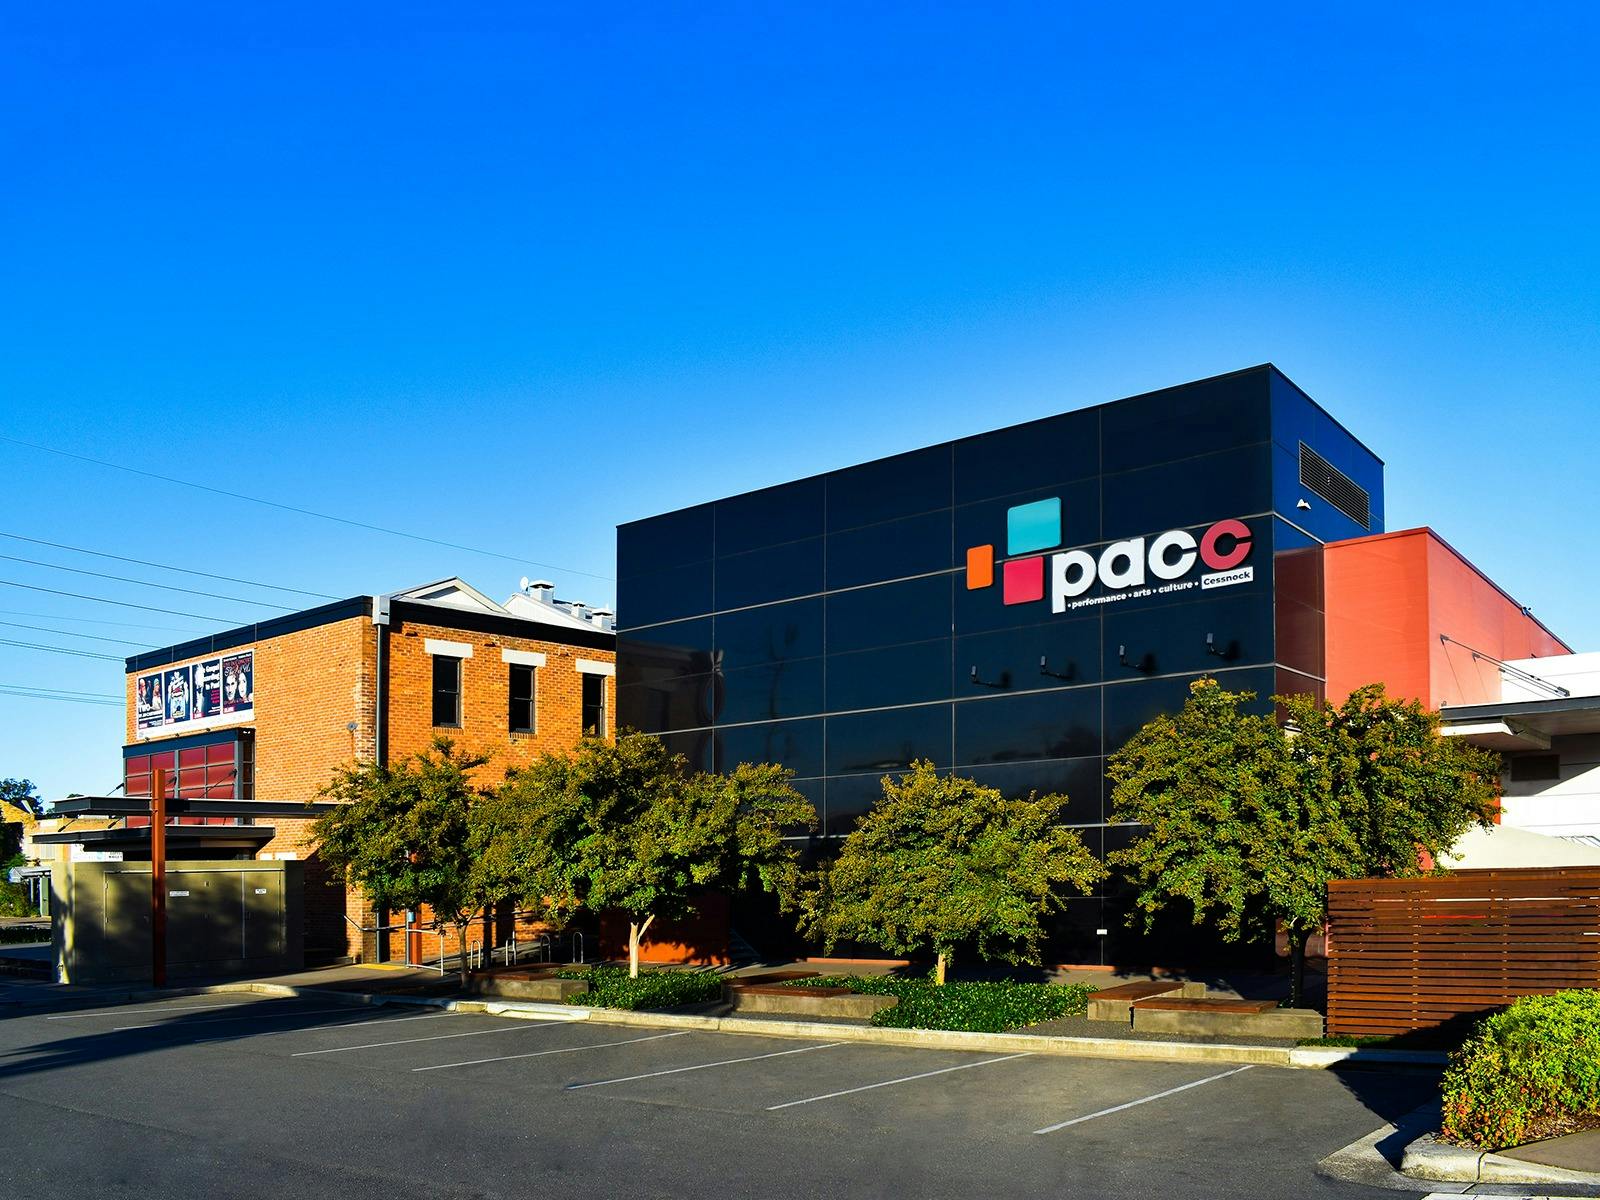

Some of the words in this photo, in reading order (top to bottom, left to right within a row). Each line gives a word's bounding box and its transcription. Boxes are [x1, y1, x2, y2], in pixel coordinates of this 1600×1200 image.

[1052, 518, 1252, 614] pacc
[1203, 571, 1251, 586] Cessnock
[1072, 594, 1127, 610] performance
[1133, 587, 1151, 599] arts
[1158, 580, 1193, 594] culture
